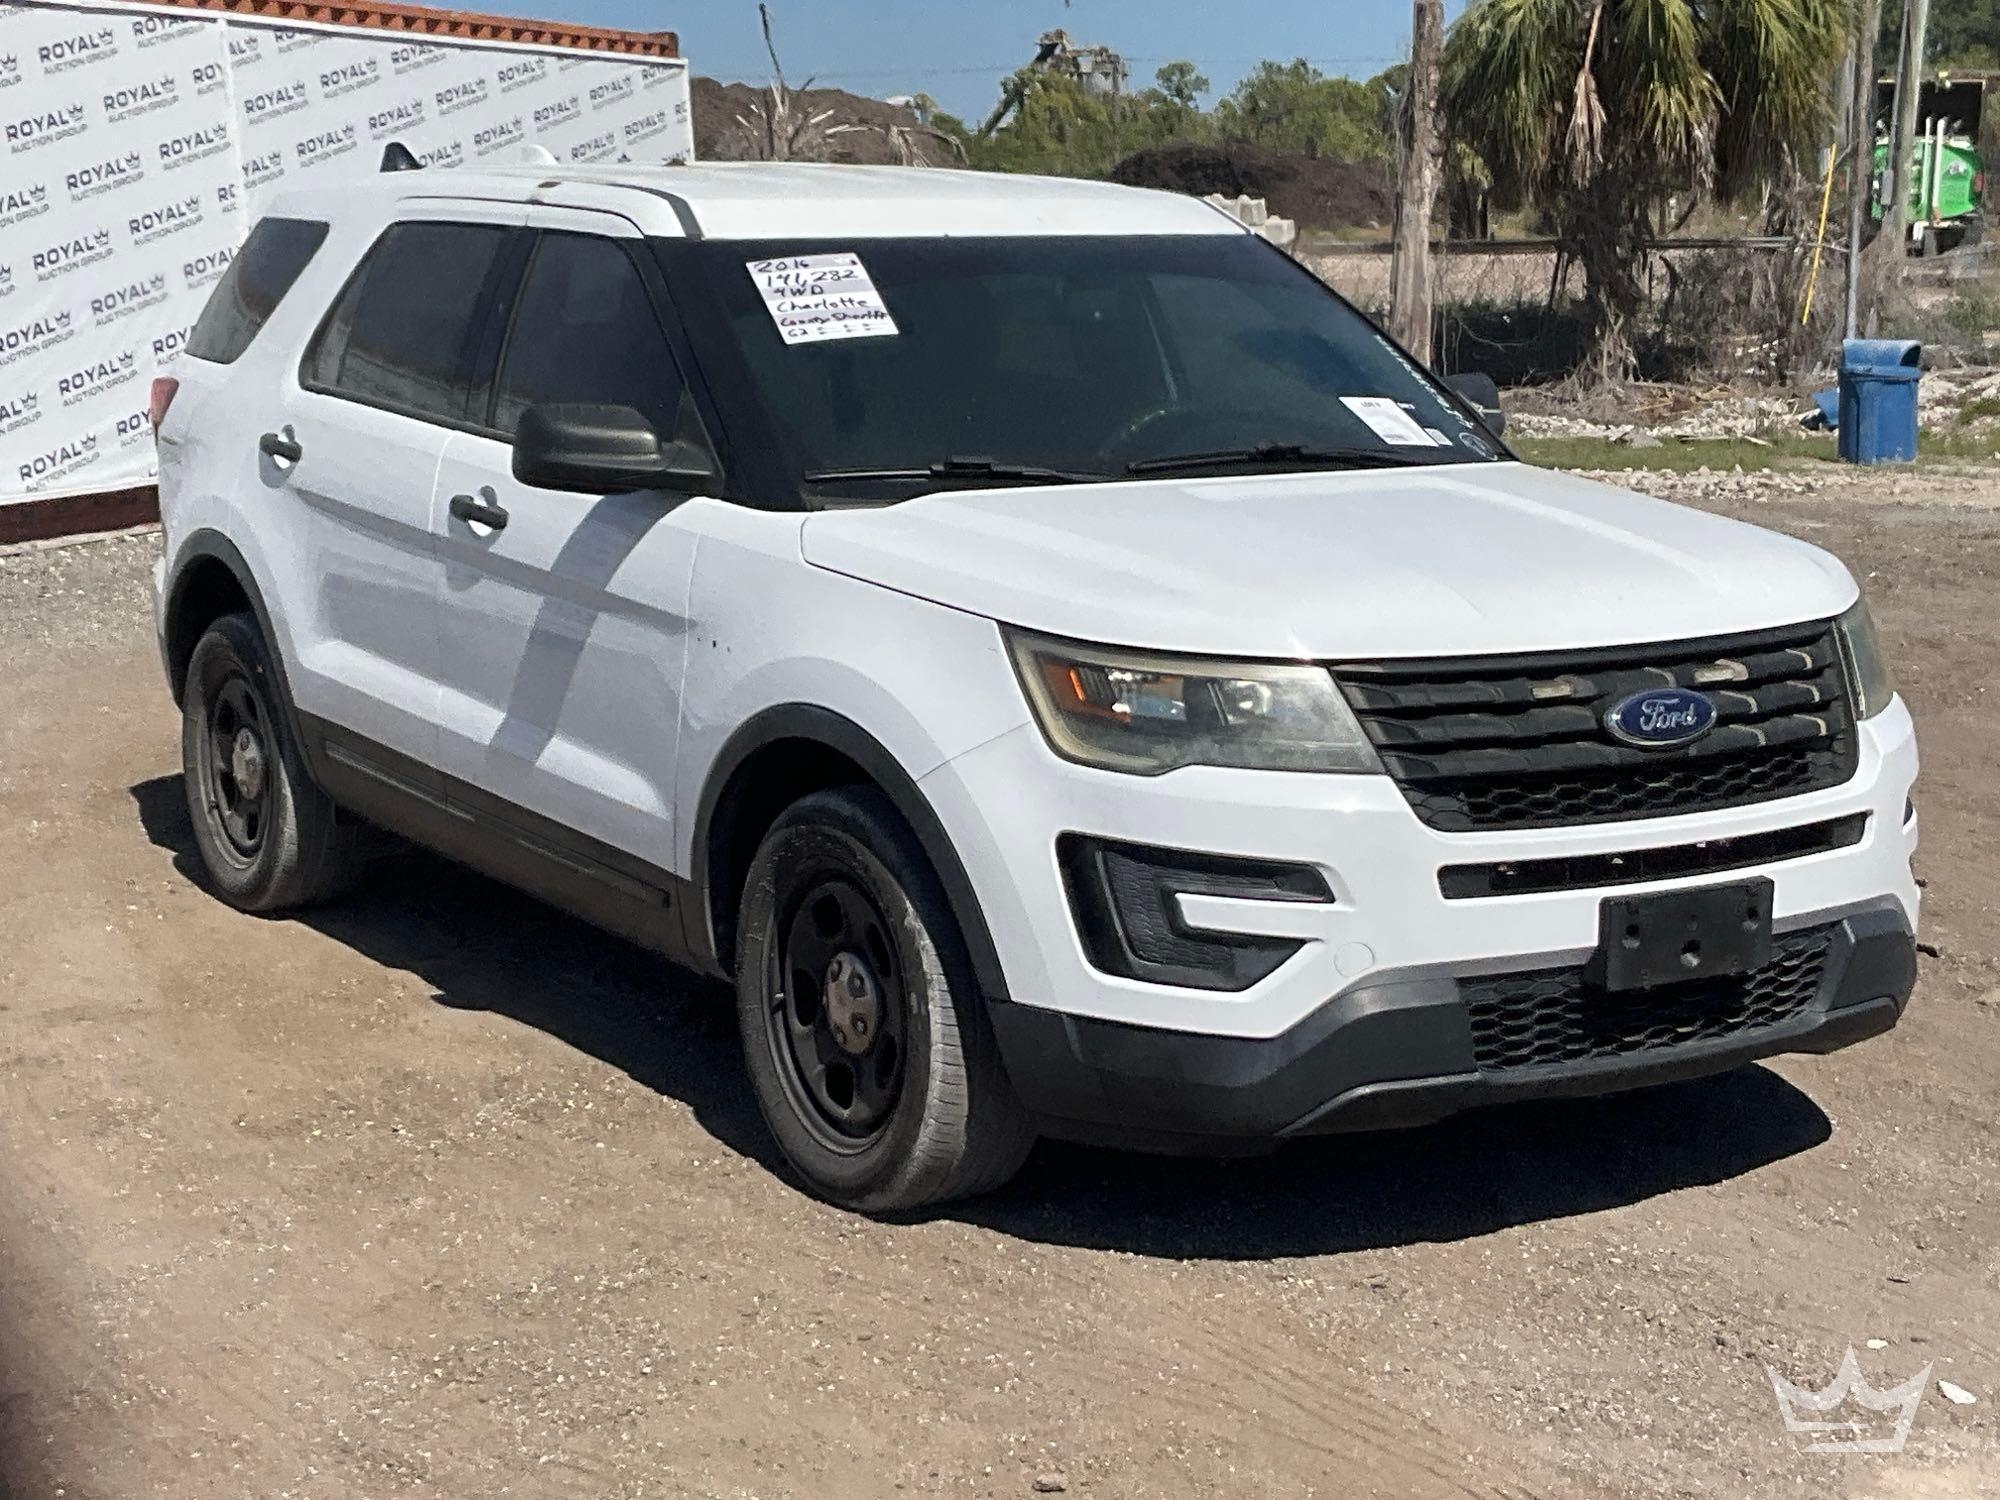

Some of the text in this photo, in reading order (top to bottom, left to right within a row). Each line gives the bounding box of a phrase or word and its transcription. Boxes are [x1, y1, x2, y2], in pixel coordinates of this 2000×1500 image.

[39, 34, 99, 62] ROYAL
[320, 63, 367, 88] ROYAL
[497, 61, 535, 83] ROYAL
[105, 82, 161, 111] ROYAL
[244, 87, 294, 114] ROYAL
[436, 81, 476, 106] ROYAL
[590, 79, 624, 100] ROYAL
[369, 104, 412, 130] ROYAL
[534, 102, 571, 122] ROYAL
[5, 111, 69, 142] ROYAL
[474, 122, 513, 145] ROYAL
[159, 130, 214, 159] ROYAL
[296, 130, 343, 157] ROYAL
[66, 160, 127, 191] ROYAL
[129, 203, 187, 235] ROYAL
[33, 236, 95, 271] ROYAL
[754, 258, 809, 273] 2016
[91, 281, 151, 315] ROYAL
[773, 284, 825, 298] 4WD
[777, 297, 868, 313] Charlotte
[59, 359, 120, 397] ROYAL
[19, 442, 82, 482] ROYAL
[1640, 697, 1697, 731] Ford
